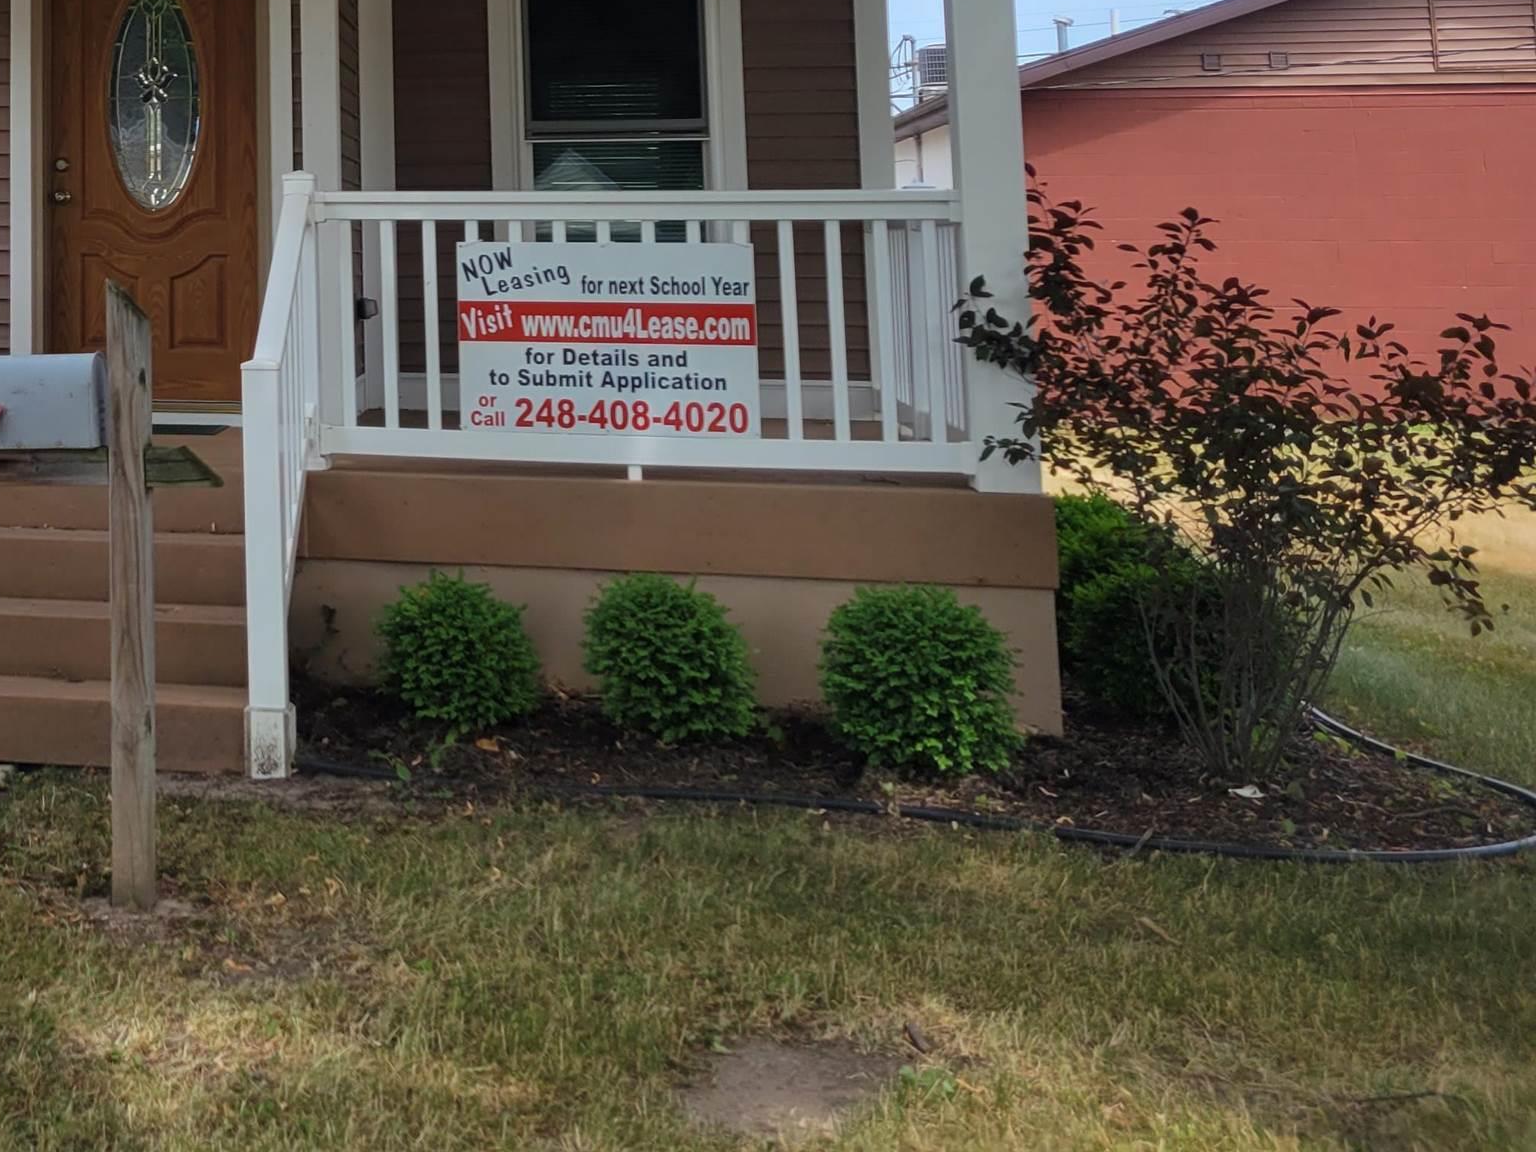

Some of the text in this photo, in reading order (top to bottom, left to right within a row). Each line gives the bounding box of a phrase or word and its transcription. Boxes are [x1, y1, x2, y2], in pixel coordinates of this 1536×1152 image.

[462, 248, 513, 281] NOW
[482, 265, 570, 296] Leasing
[582, 276, 750, 296] for next School Year
[461, 304, 750, 340] Visit www.cmu4Lease.com
[525, 348, 687, 367] for Details and
[490, 369, 727, 392] to Submit Application
[479, 395, 496, 407] or
[470, 411, 505, 426] Call
[515, 398, 748, 433] 248-408-4020
